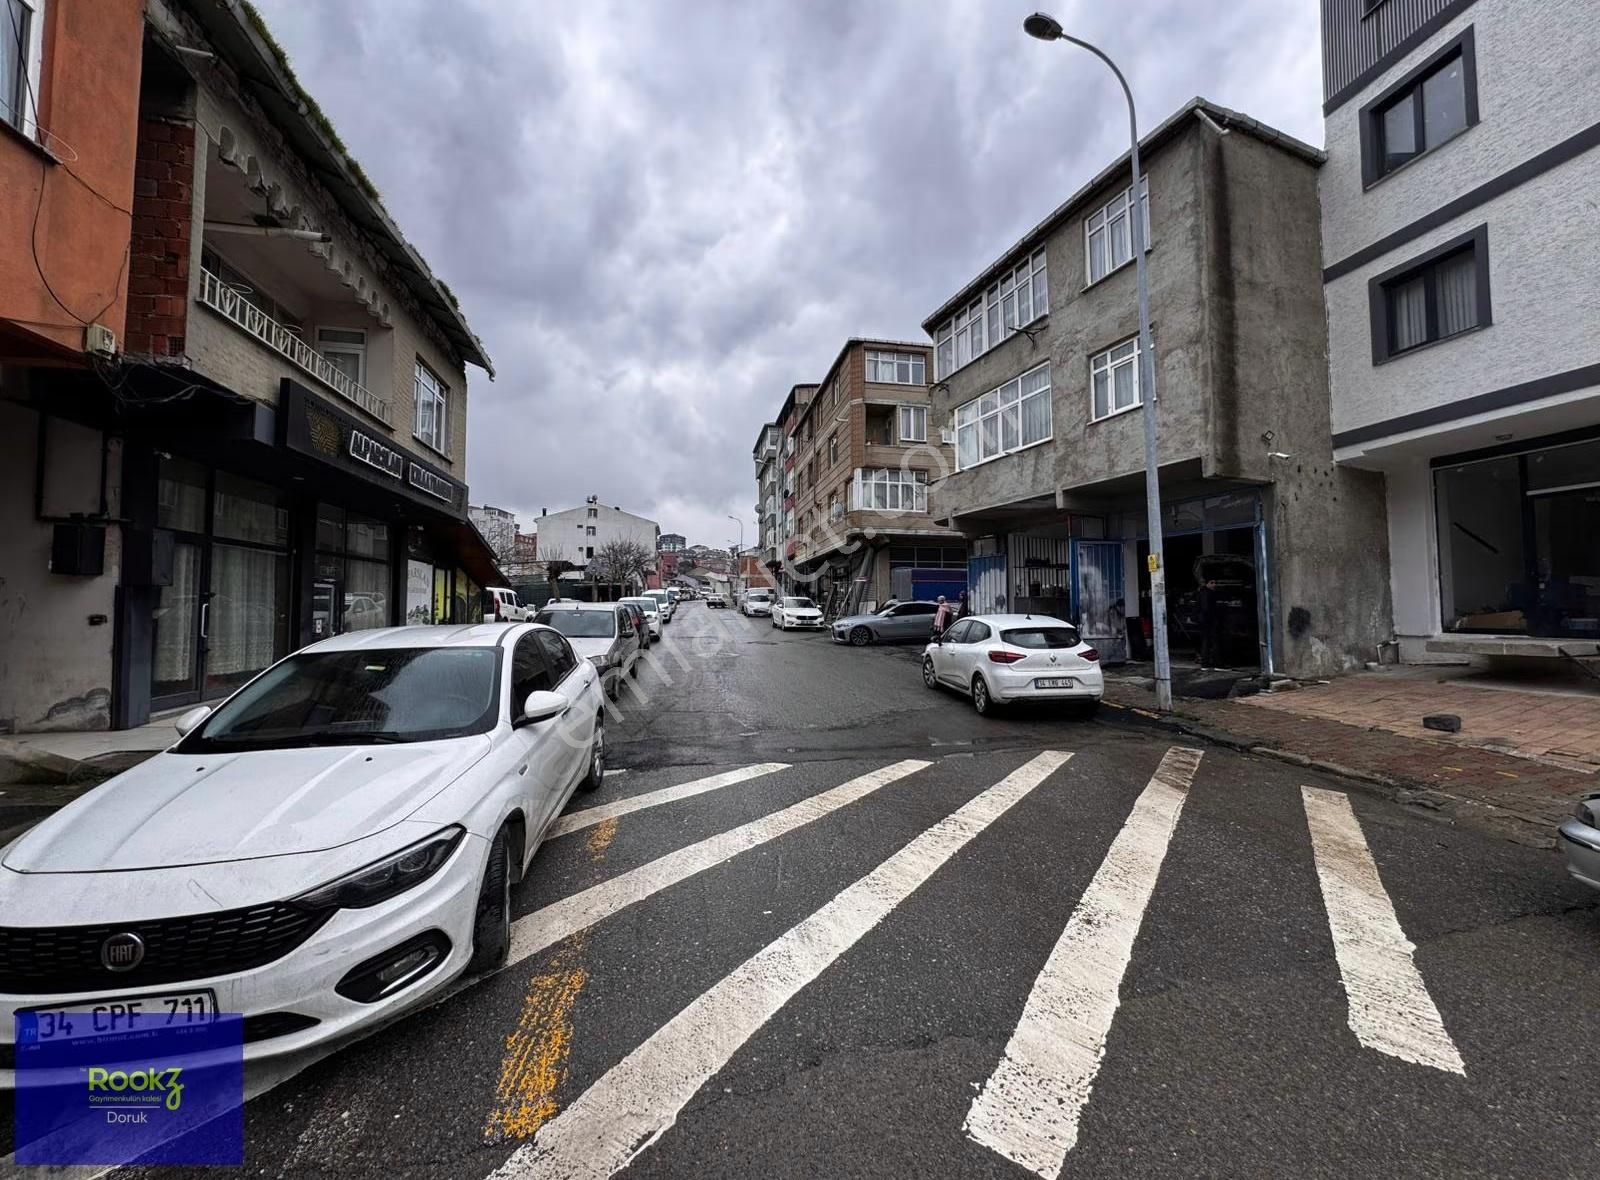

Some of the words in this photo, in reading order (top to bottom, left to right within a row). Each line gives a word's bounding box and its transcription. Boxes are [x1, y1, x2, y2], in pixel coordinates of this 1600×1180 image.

[110, 944, 134, 962] FIAT
[40, 1011, 73, 1038] 34
[92, 1002, 142, 1031] CPF
[164, 997, 204, 1024] 711
